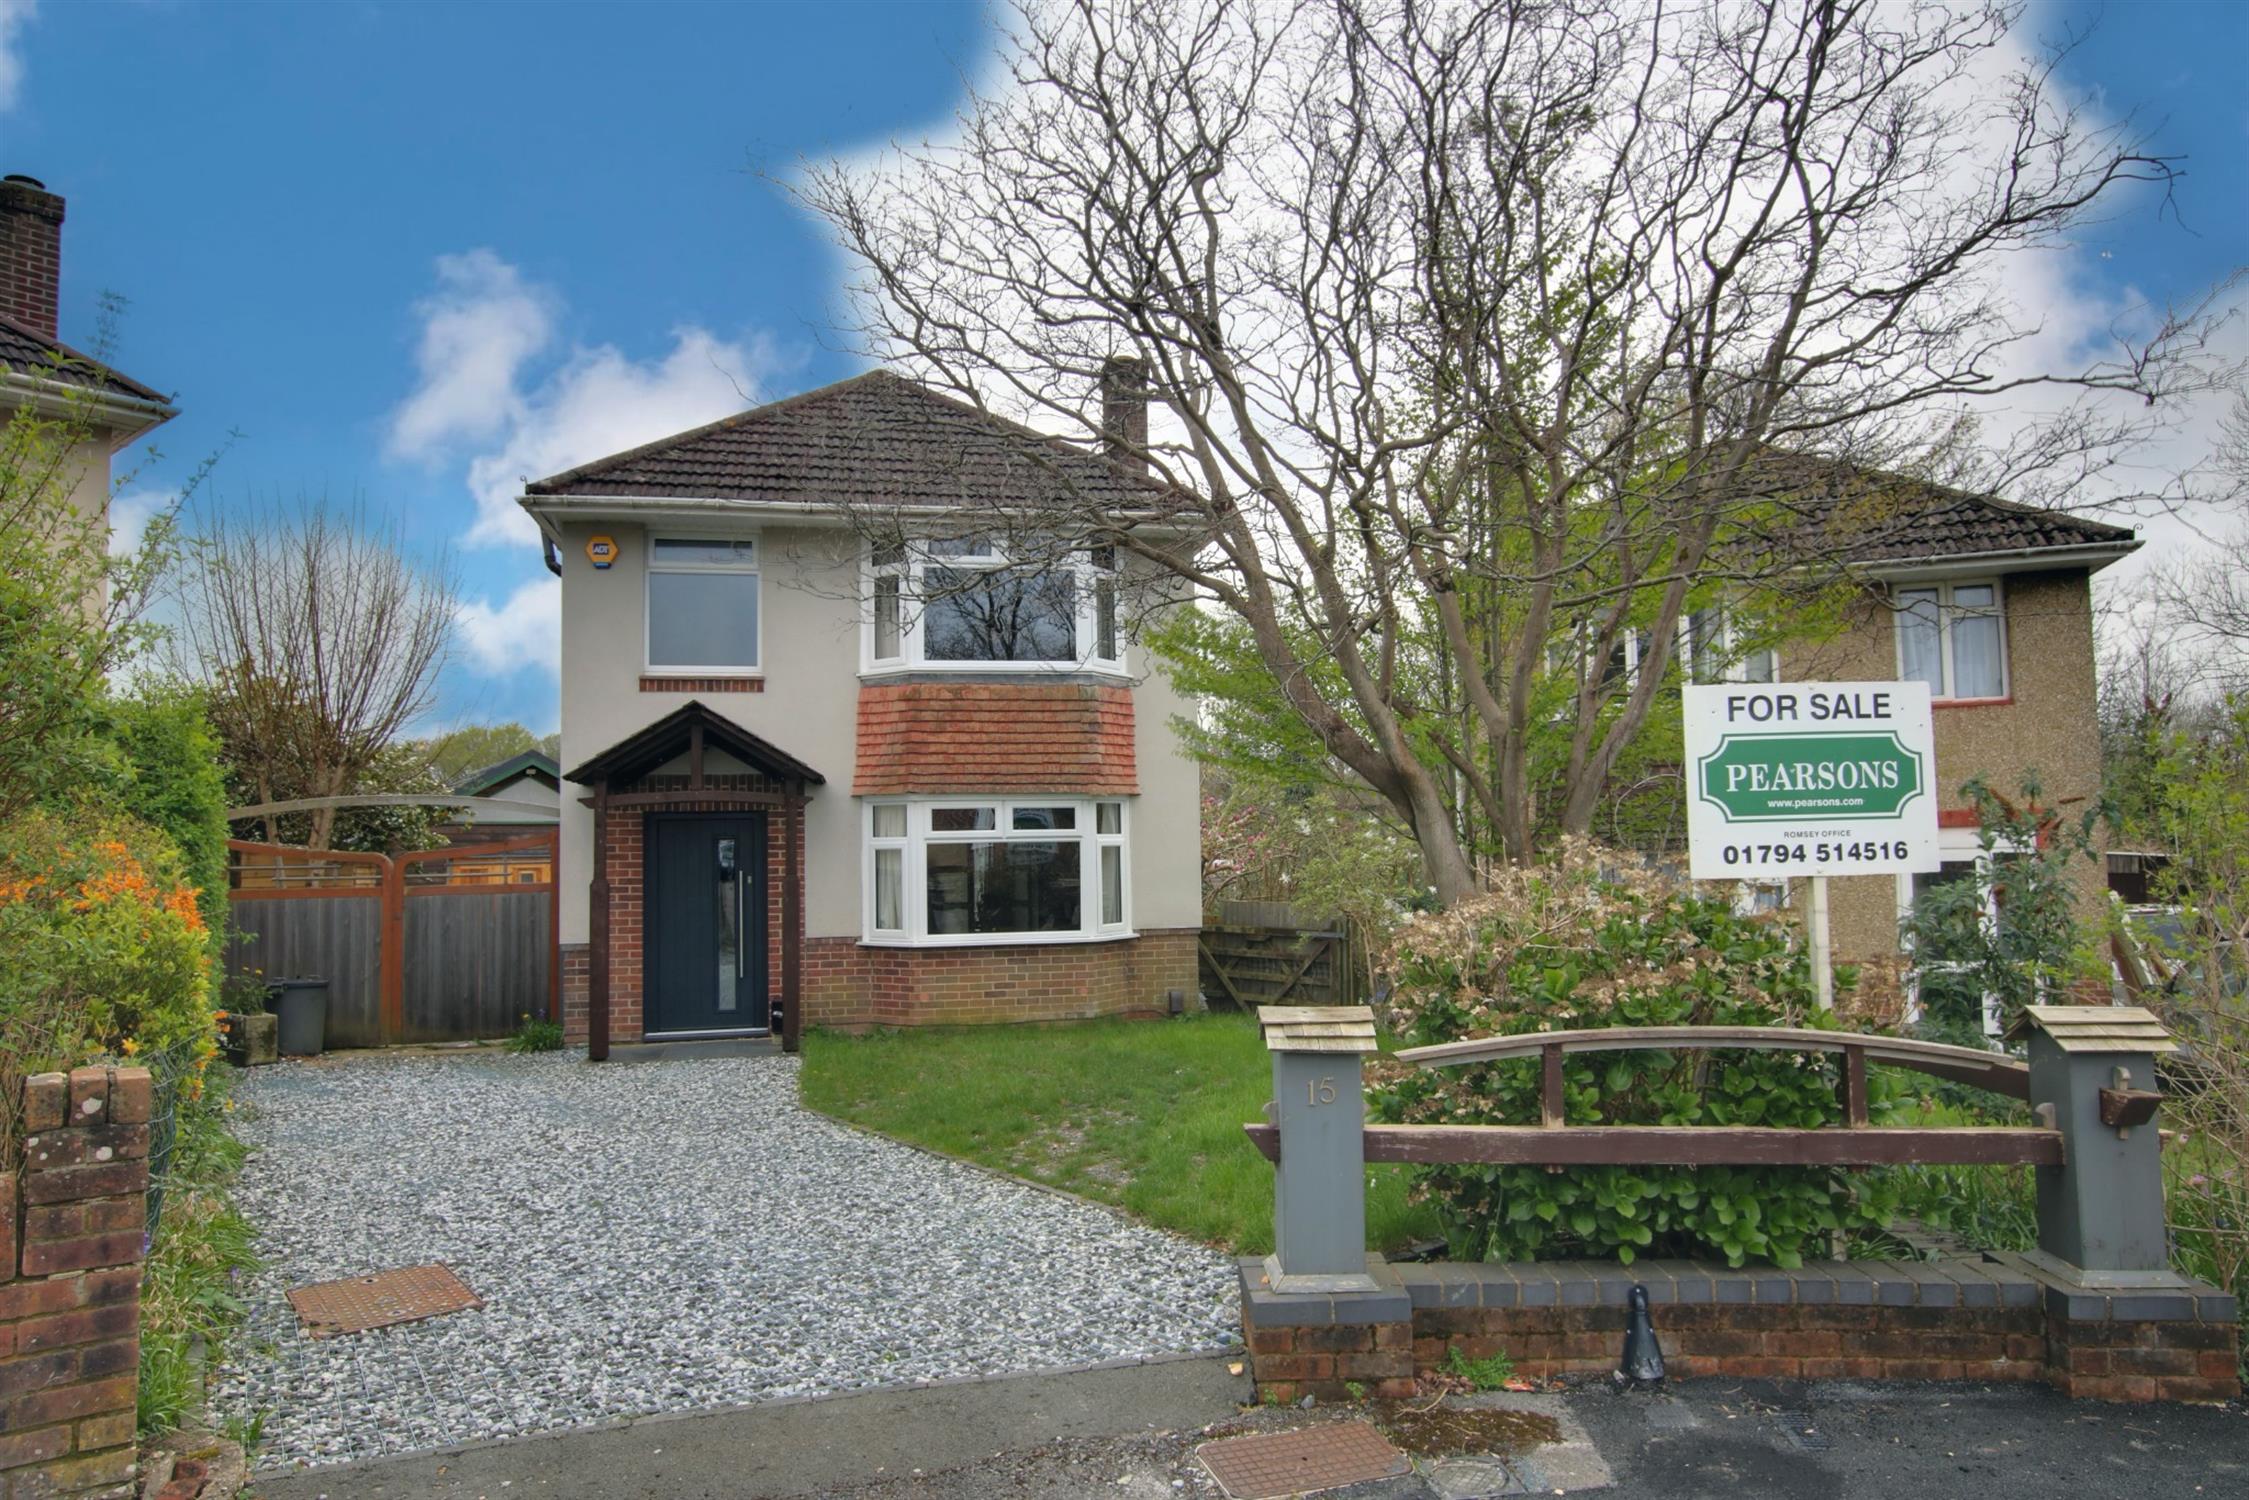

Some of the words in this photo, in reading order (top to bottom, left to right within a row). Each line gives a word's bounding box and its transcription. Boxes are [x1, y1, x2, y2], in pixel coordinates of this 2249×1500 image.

[1727, 694, 1798, 722] FOR
[1810, 693, 1892, 719] SALE
[1725, 760, 1899, 792] PEARSONS
[1768, 797, 1863, 808] www.pearsons.com
[1821, 829, 1851, 837] OFFICE
[1723, 844, 1806, 864] 01794
[1816, 841, 1908, 862] 514516
[1307, 1076, 1336, 1107] 15
